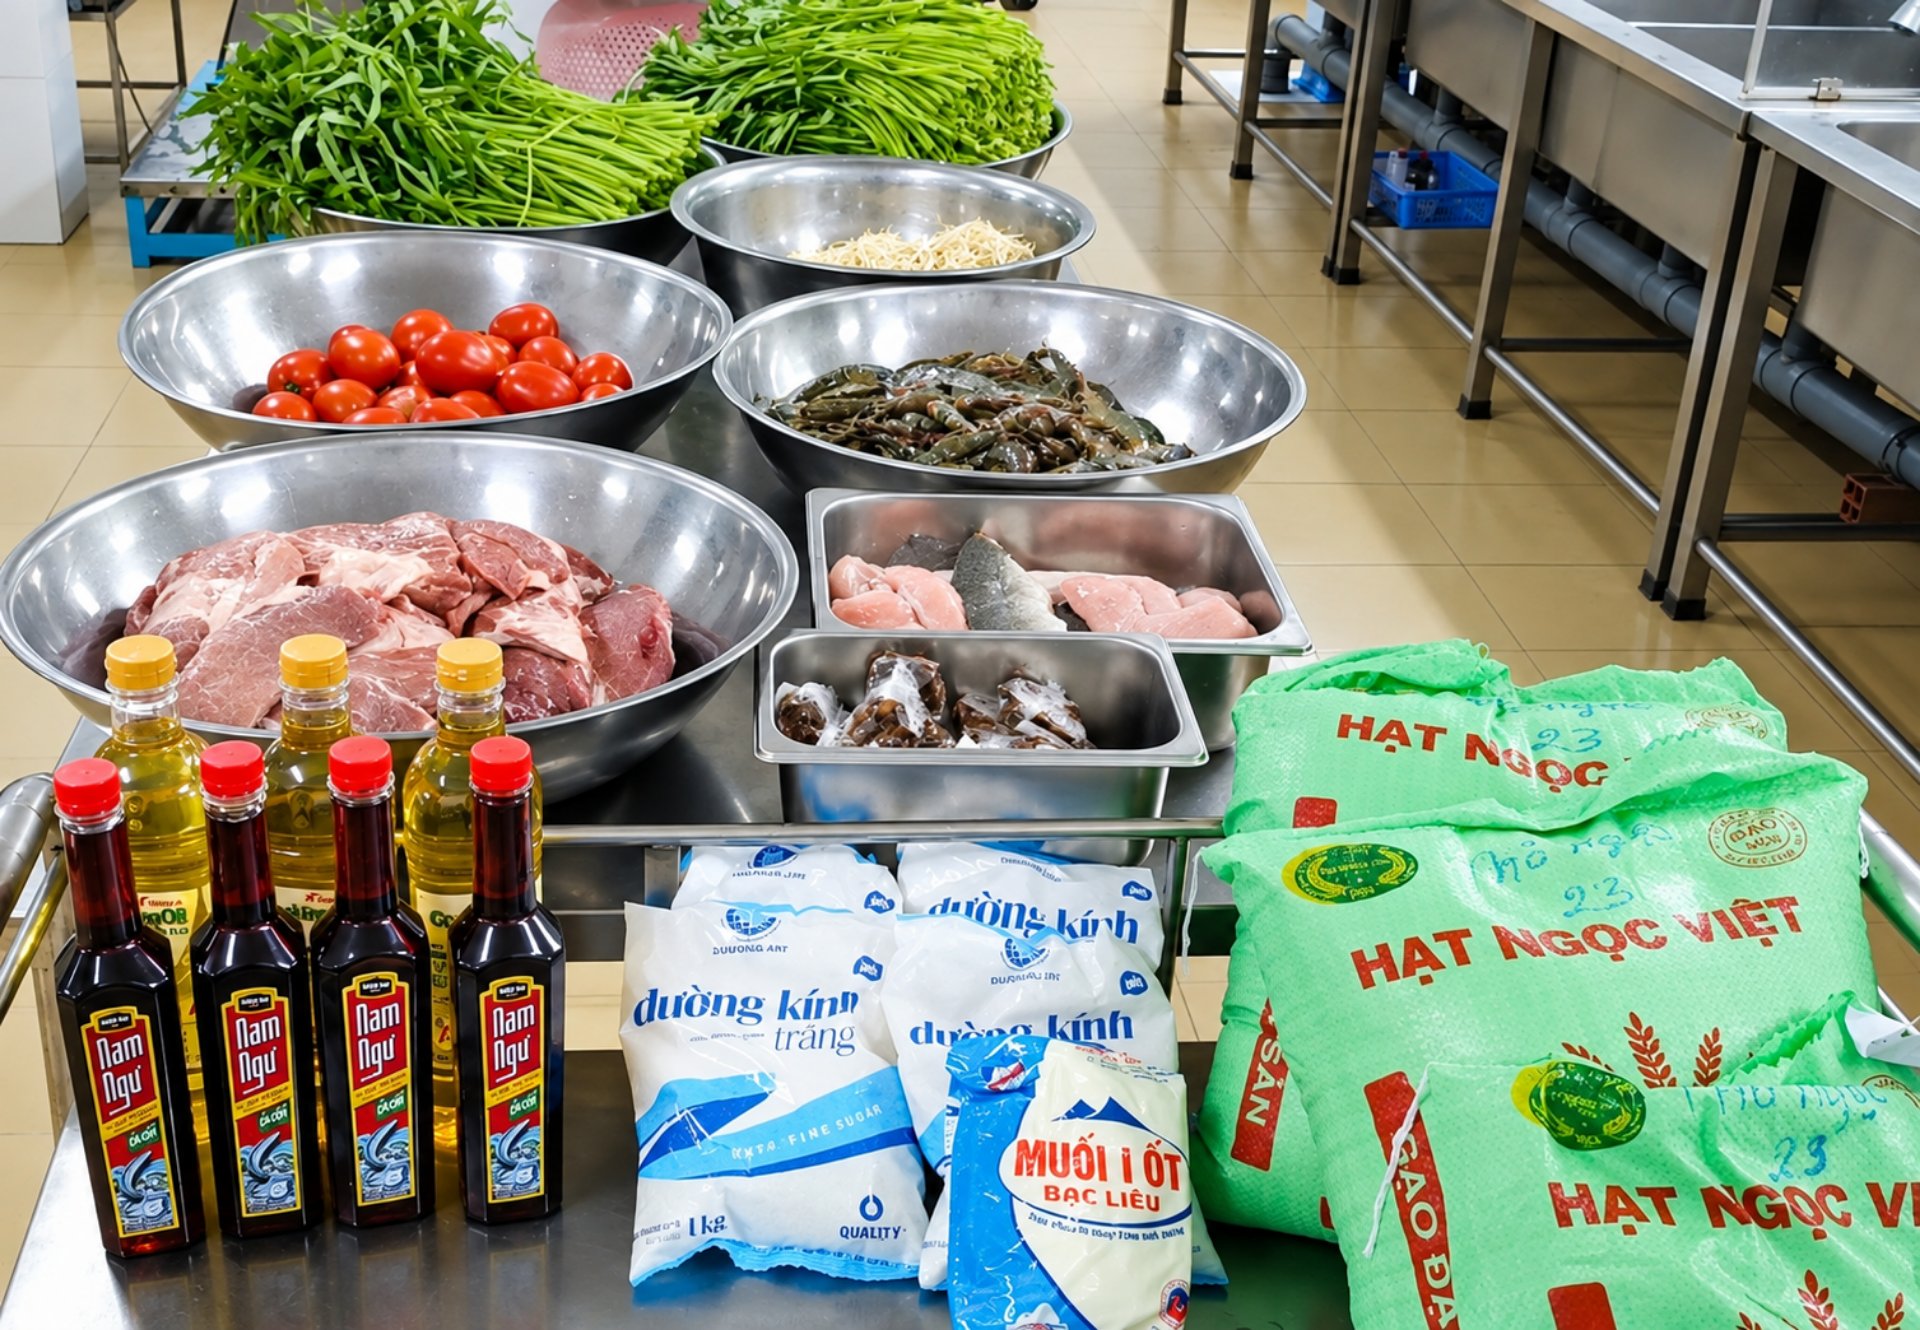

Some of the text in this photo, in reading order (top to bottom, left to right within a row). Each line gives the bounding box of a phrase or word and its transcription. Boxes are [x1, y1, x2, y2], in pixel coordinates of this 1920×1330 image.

[1336, 712, 1609, 794] HẠT NGỌC
[1350, 894, 1803, 990] HẠT NGỌC VIỆT
[235, 1015, 281, 1050] Nam
[355, 1001, 401, 1037] Nam
[492, 1004, 536, 1039] Nam
[95, 1033, 144, 1071] Nam
[788, 1124, 831, 1146] FINE
[1014, 1132, 1108, 1182] MUỐI
[1143, 1139, 1182, 1191] ỐT
[1043, 1185, 1161, 1213] BẠC LIÊU
[1547, 1181, 1920, 1241] HẠT NGỌC VI
[839, 1225, 902, 1241] QUALITY
